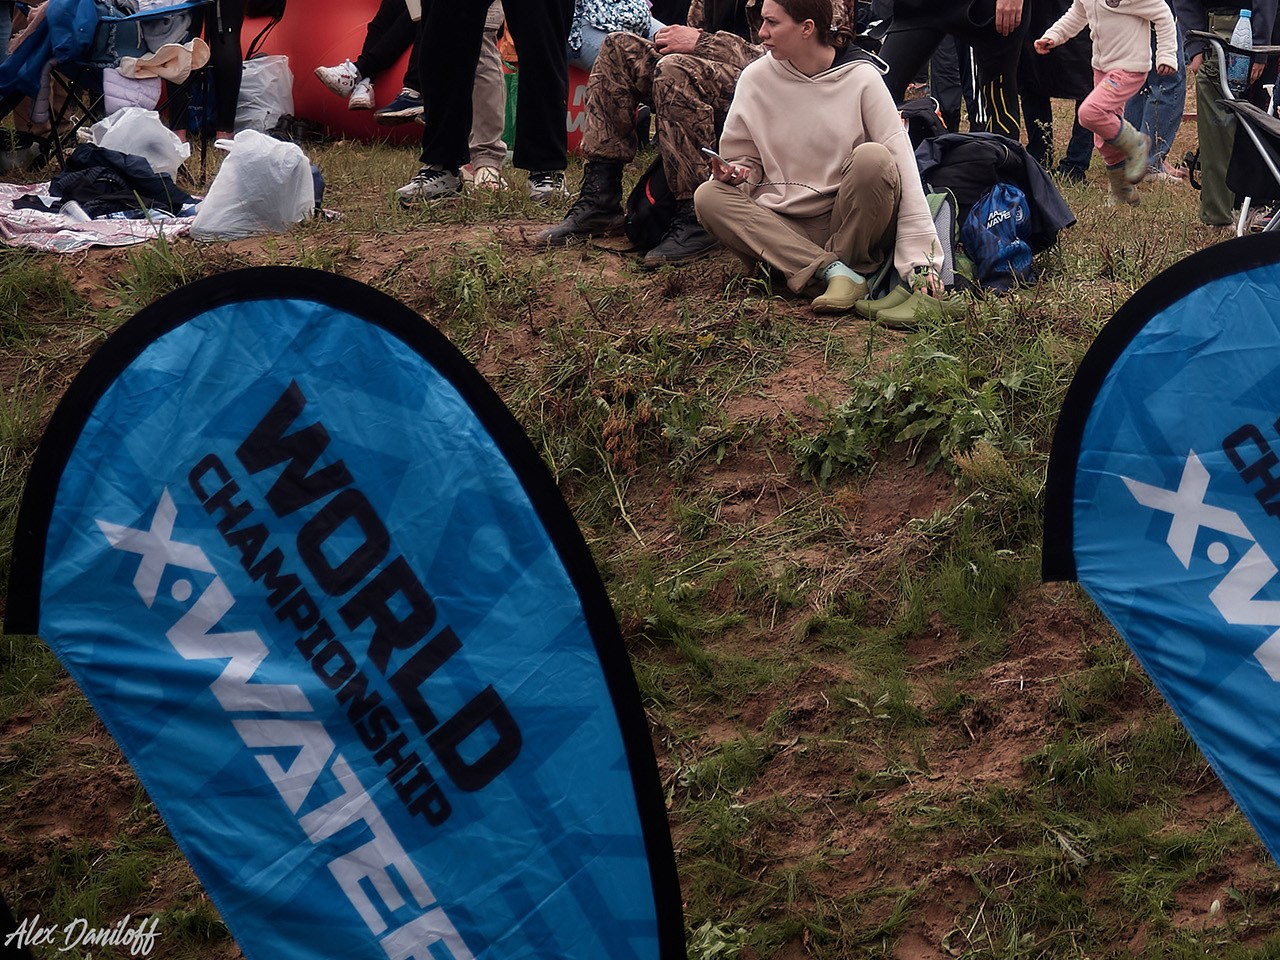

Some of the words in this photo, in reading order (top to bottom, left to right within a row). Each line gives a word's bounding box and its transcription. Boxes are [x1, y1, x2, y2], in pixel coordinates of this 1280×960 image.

[986, 211, 1011, 229] WAVE
[187, 453, 453, 827] CHAMPIONSHIP
[235, 378, 522, 794] WORLD
